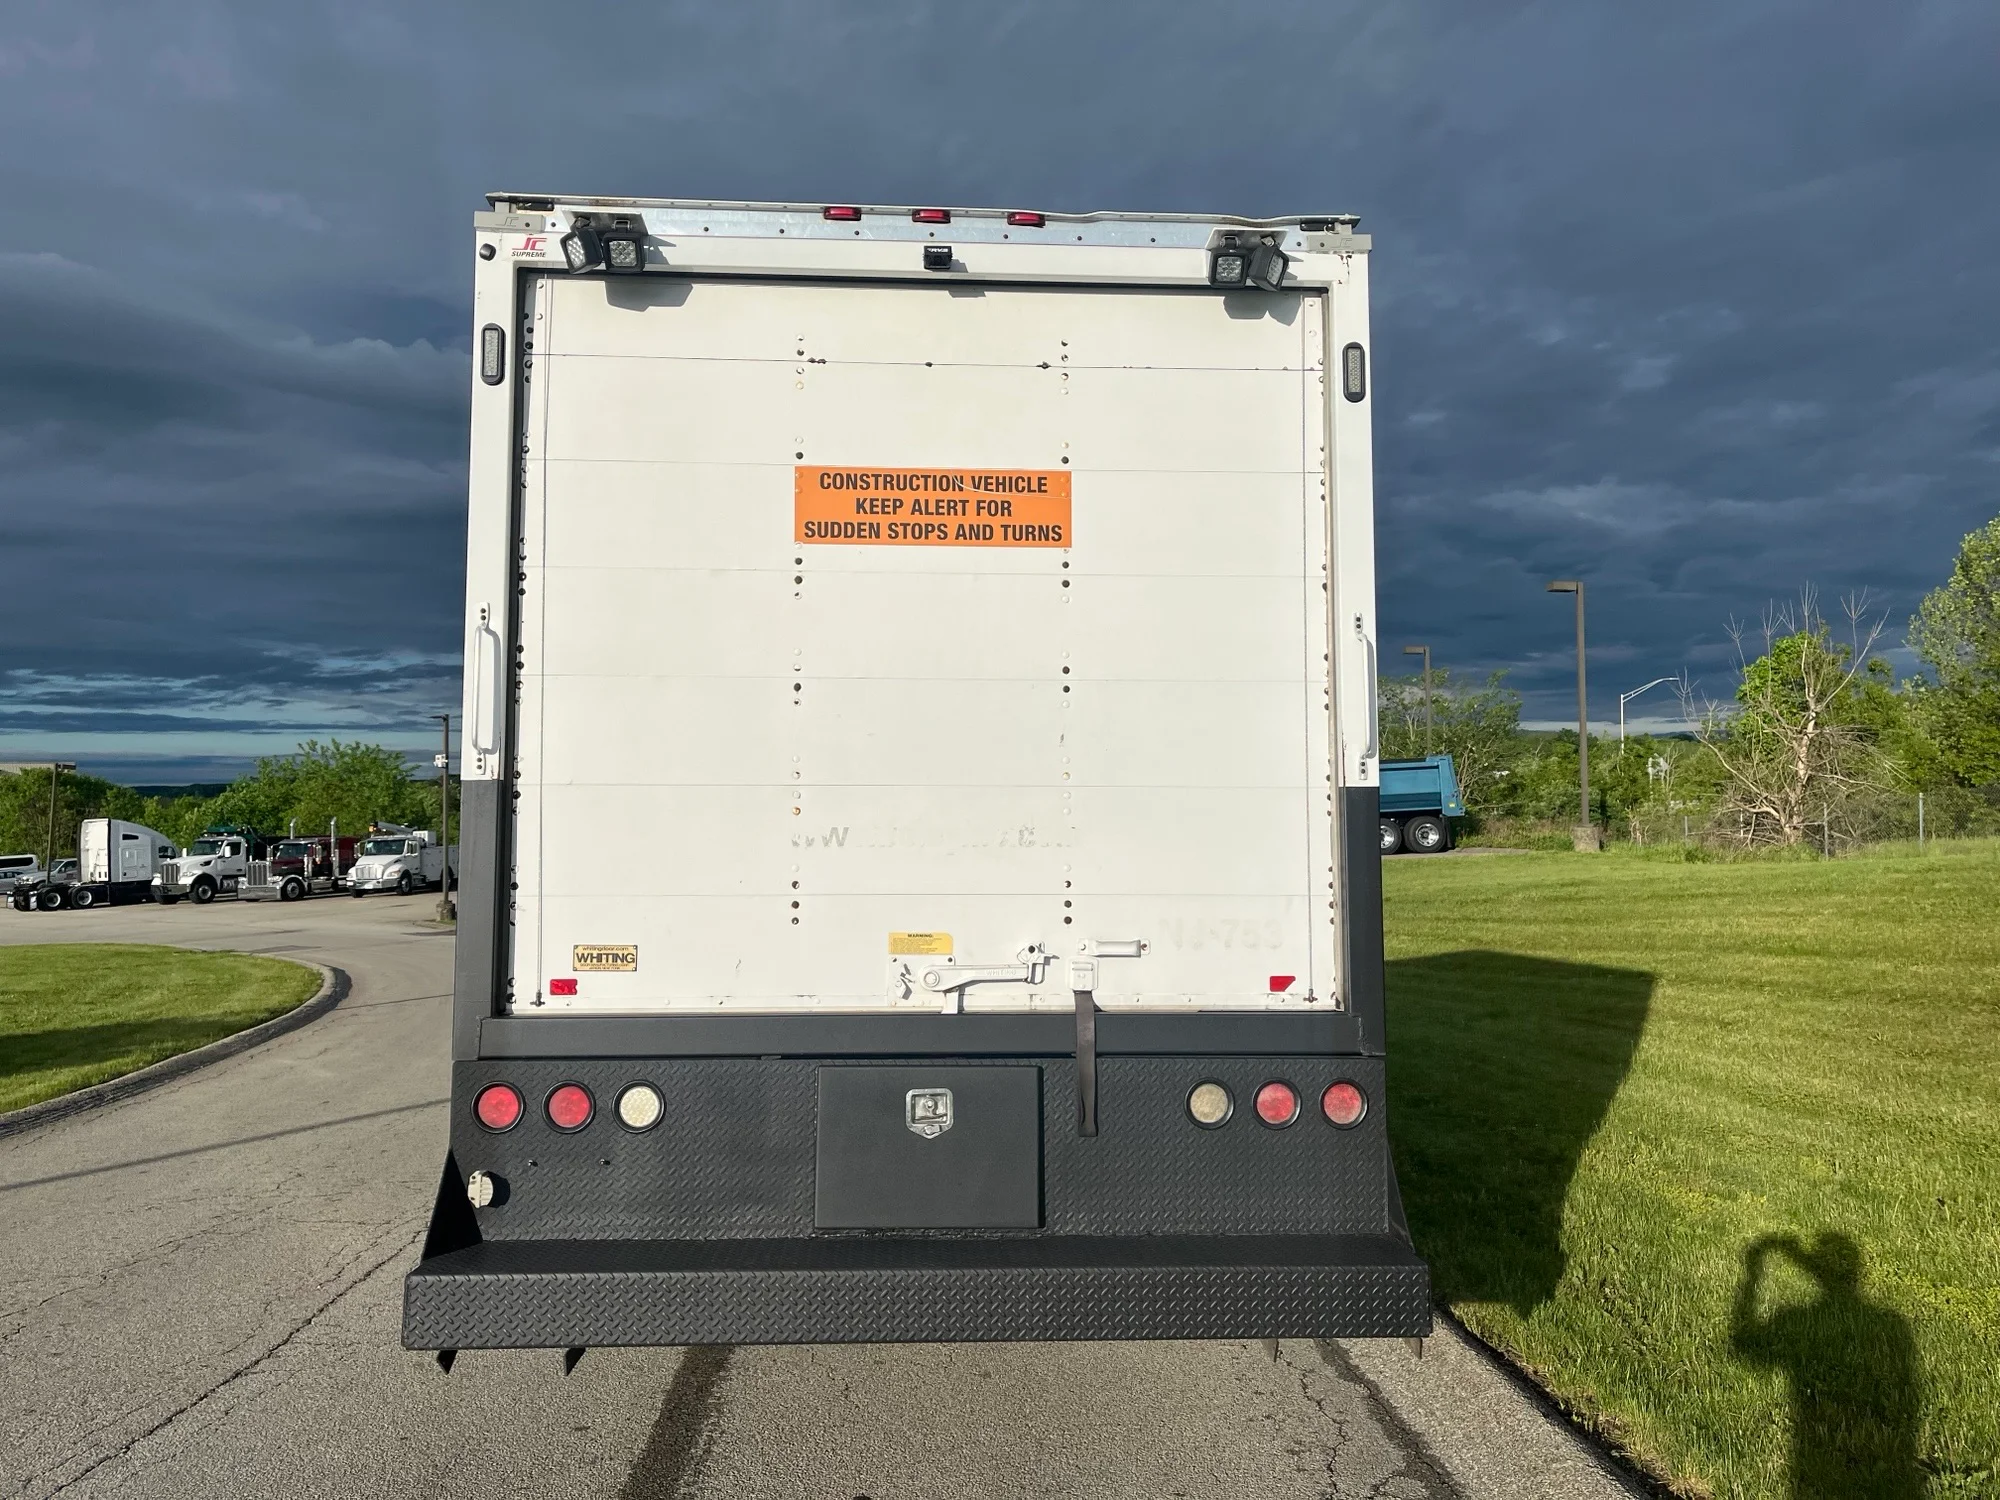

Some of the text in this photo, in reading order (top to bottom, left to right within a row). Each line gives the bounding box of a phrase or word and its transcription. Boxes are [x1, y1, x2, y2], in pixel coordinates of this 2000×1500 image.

[819, 472, 1048, 494] CONSTRUCTION VEHICLE
[855, 497, 1012, 517] KEEP ALERT FOR
[804, 521, 1063, 542] SUDDEN STOPS AND TURNS
[576, 953, 635, 963] WHITING
